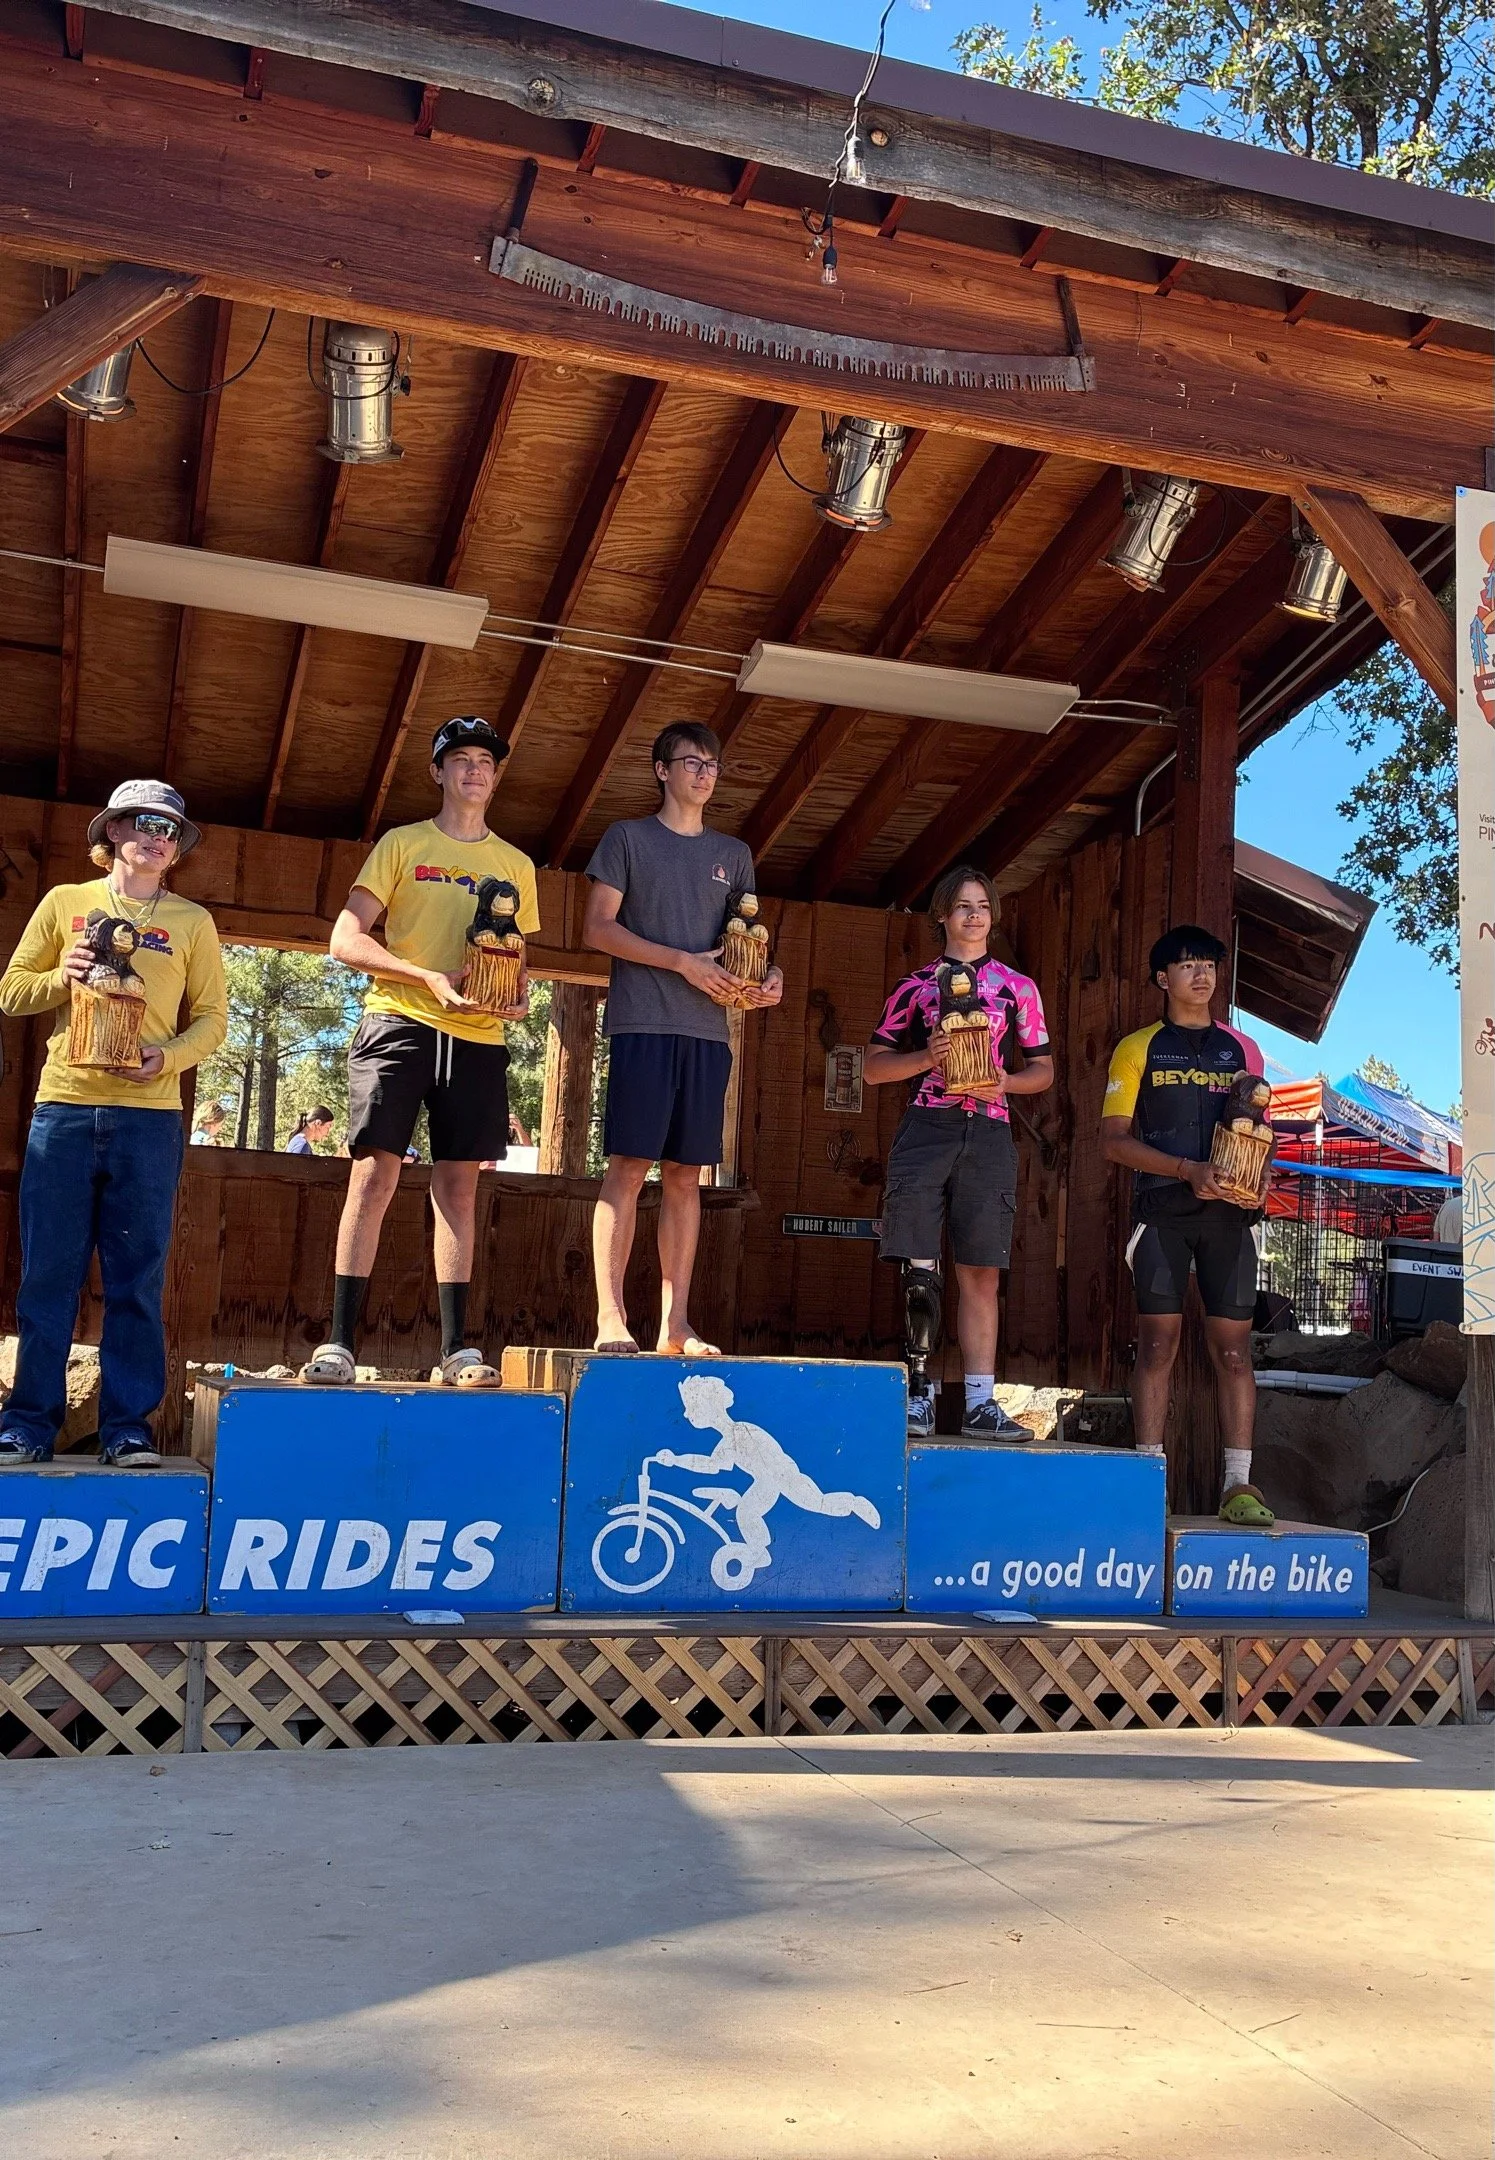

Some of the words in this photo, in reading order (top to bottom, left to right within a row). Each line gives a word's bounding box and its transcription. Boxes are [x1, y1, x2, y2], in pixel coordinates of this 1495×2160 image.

[793, 1218, 824, 1232] HUBERT
[1412, 1263, 1441, 1275] EVENT
[219, 1518, 502, 1591] RIDES
[1001, 1548, 1086, 1599] good
[1096, 1548, 1155, 1598] day
[1176, 1563, 1213, 1591] on
[1227, 1553, 1276, 1592] the
[1287, 1555, 1353, 1593] bike
